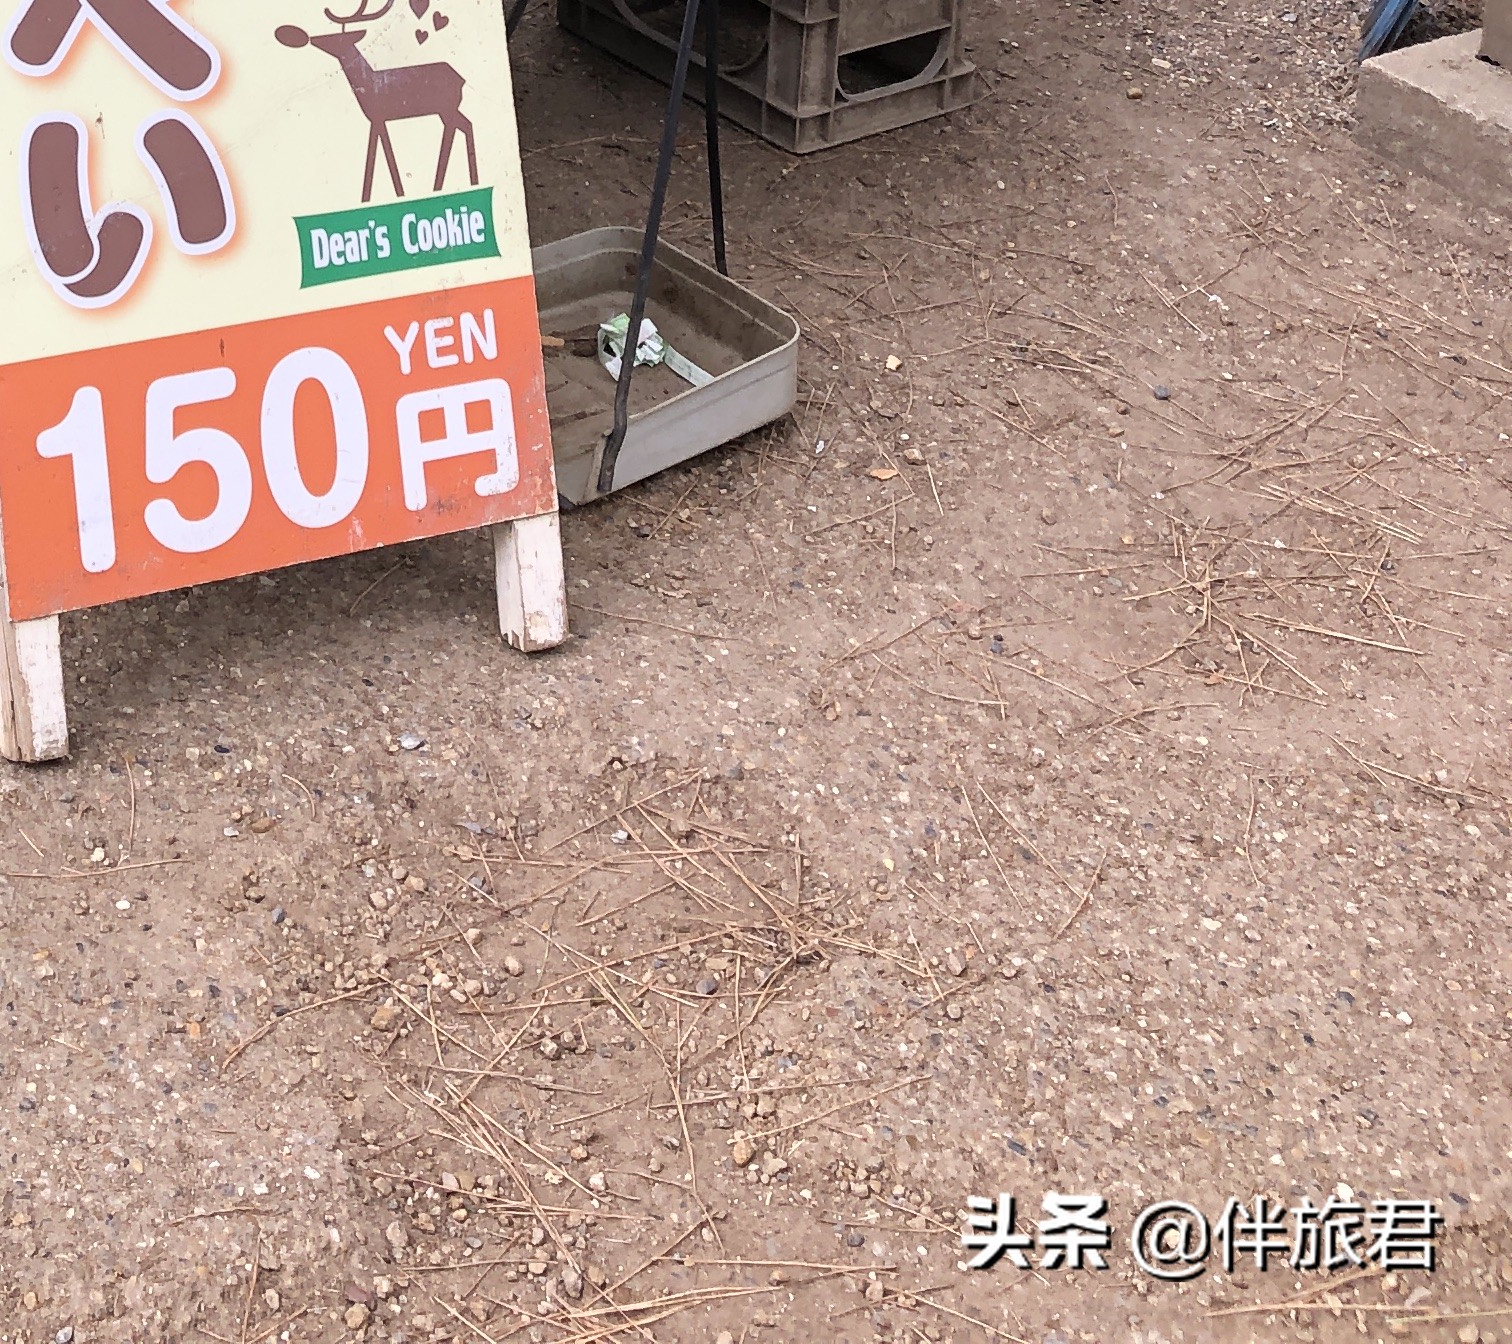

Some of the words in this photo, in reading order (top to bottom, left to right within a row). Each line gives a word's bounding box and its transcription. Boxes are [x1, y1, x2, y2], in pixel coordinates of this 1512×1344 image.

[310, 219, 391, 270] Dear's
[401, 206, 486, 255] Cookie
[383, 308, 498, 376] YEN
